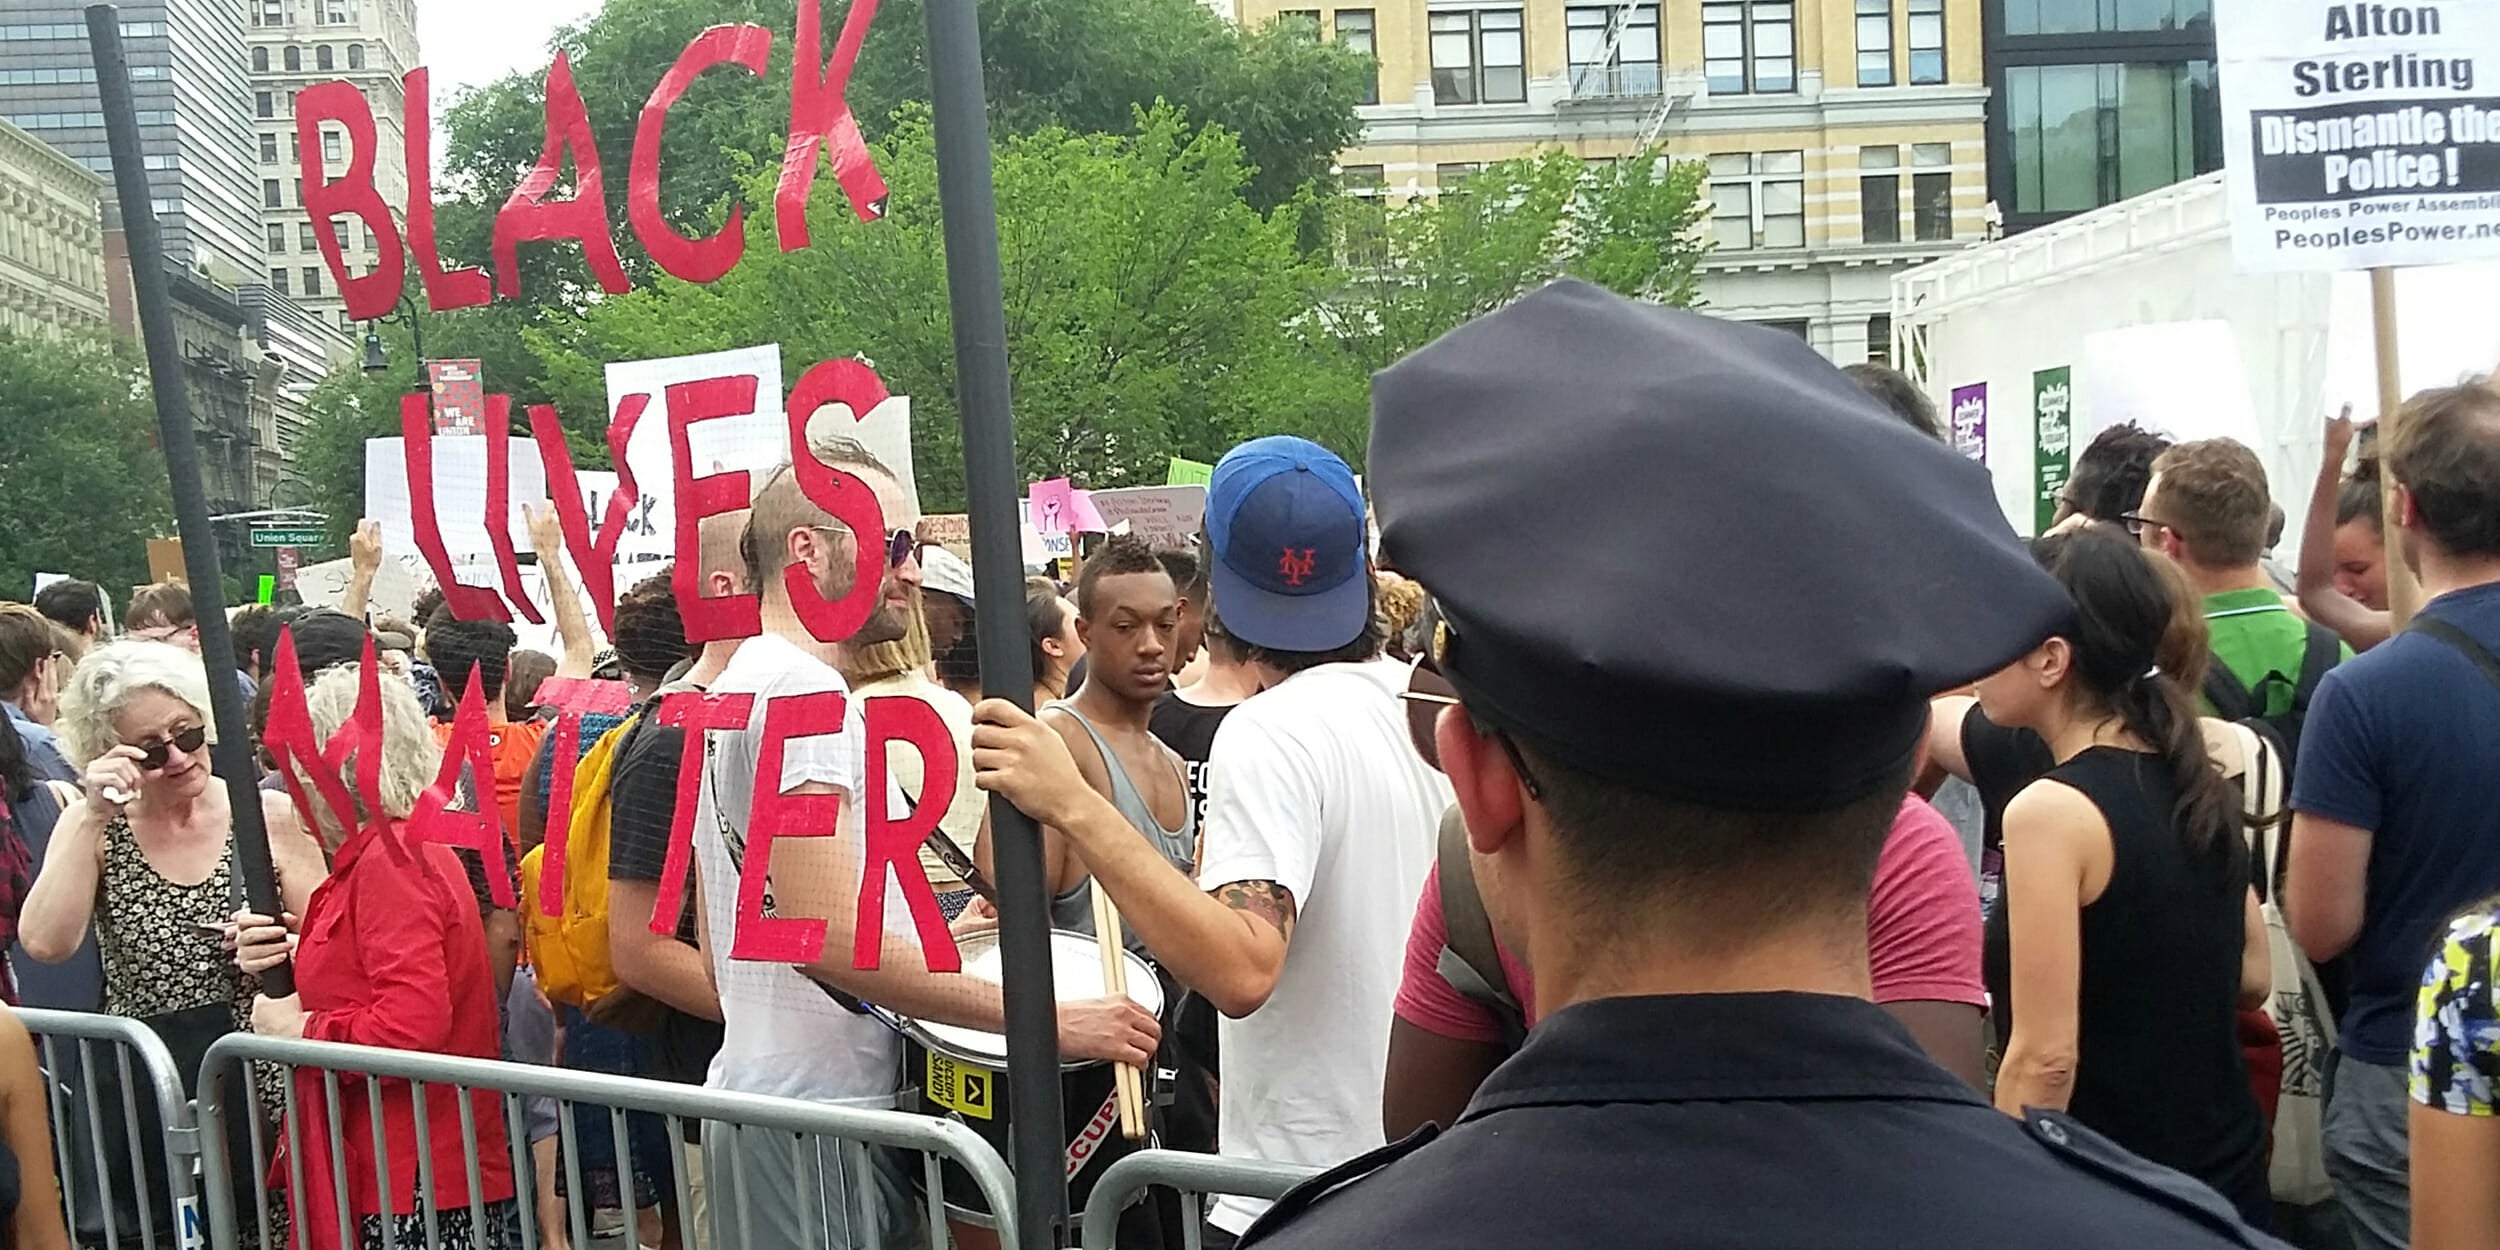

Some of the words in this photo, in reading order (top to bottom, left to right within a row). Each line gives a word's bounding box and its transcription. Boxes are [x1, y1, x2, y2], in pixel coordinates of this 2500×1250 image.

[2325, 3, 2441, 41] Alton
[2293, 54, 2474, 97] Sterling
[2260, 106, 2446, 155] Dismantle
[2449, 104, 2500, 144] the
[296, 0, 889, 321] BLACK
[2265, 206, 2342, 222] Peoples
[2349, 198, 2410, 217] Power
[402, 356, 890, 644] LIVES
[255, 533, 287, 543] Union
[263, 621, 962, 973] MATTER
[932, 1053, 944, 1102] SANDY
[945, 1059, 955, 1106] OCCUPY
[1065, 1091, 1118, 1175] CUP
